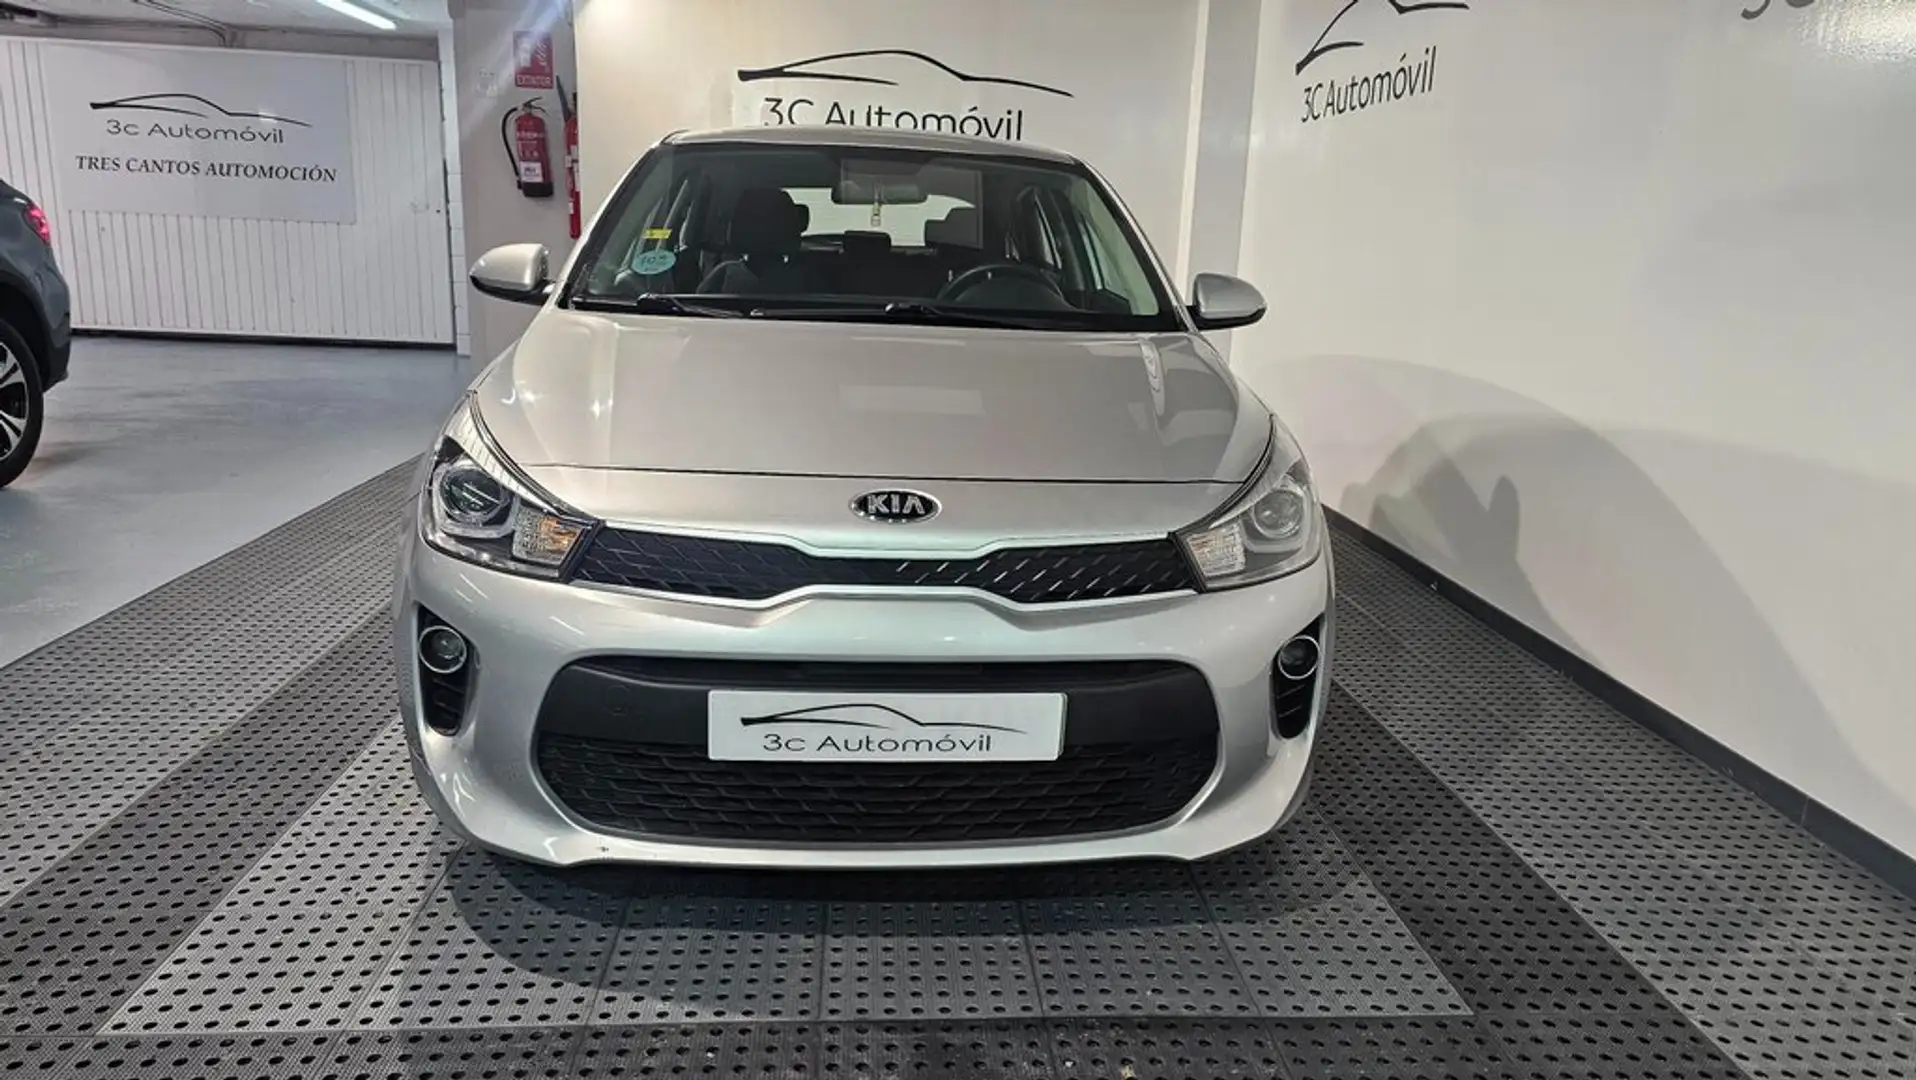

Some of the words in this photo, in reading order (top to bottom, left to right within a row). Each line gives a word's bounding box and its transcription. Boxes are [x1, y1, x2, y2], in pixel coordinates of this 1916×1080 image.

[1302, 82, 1324, 123] 3C
[1323, 45, 1437, 117] Automóvil
[106, 118, 140, 136] 3c
[148, 123, 284, 144] Automóvil
[764, 97, 814, 125] 3C
[825, 101, 1023, 141] Automóvil
[75, 154, 121, 172] TRES
[125, 157, 201, 176] CANTOS
[204, 161, 337, 182] AUTOMOCIÓN
[867, 494, 926, 514] KIA
[763, 733, 806, 752] 3c
[816, 733, 992, 753] Automóvil
